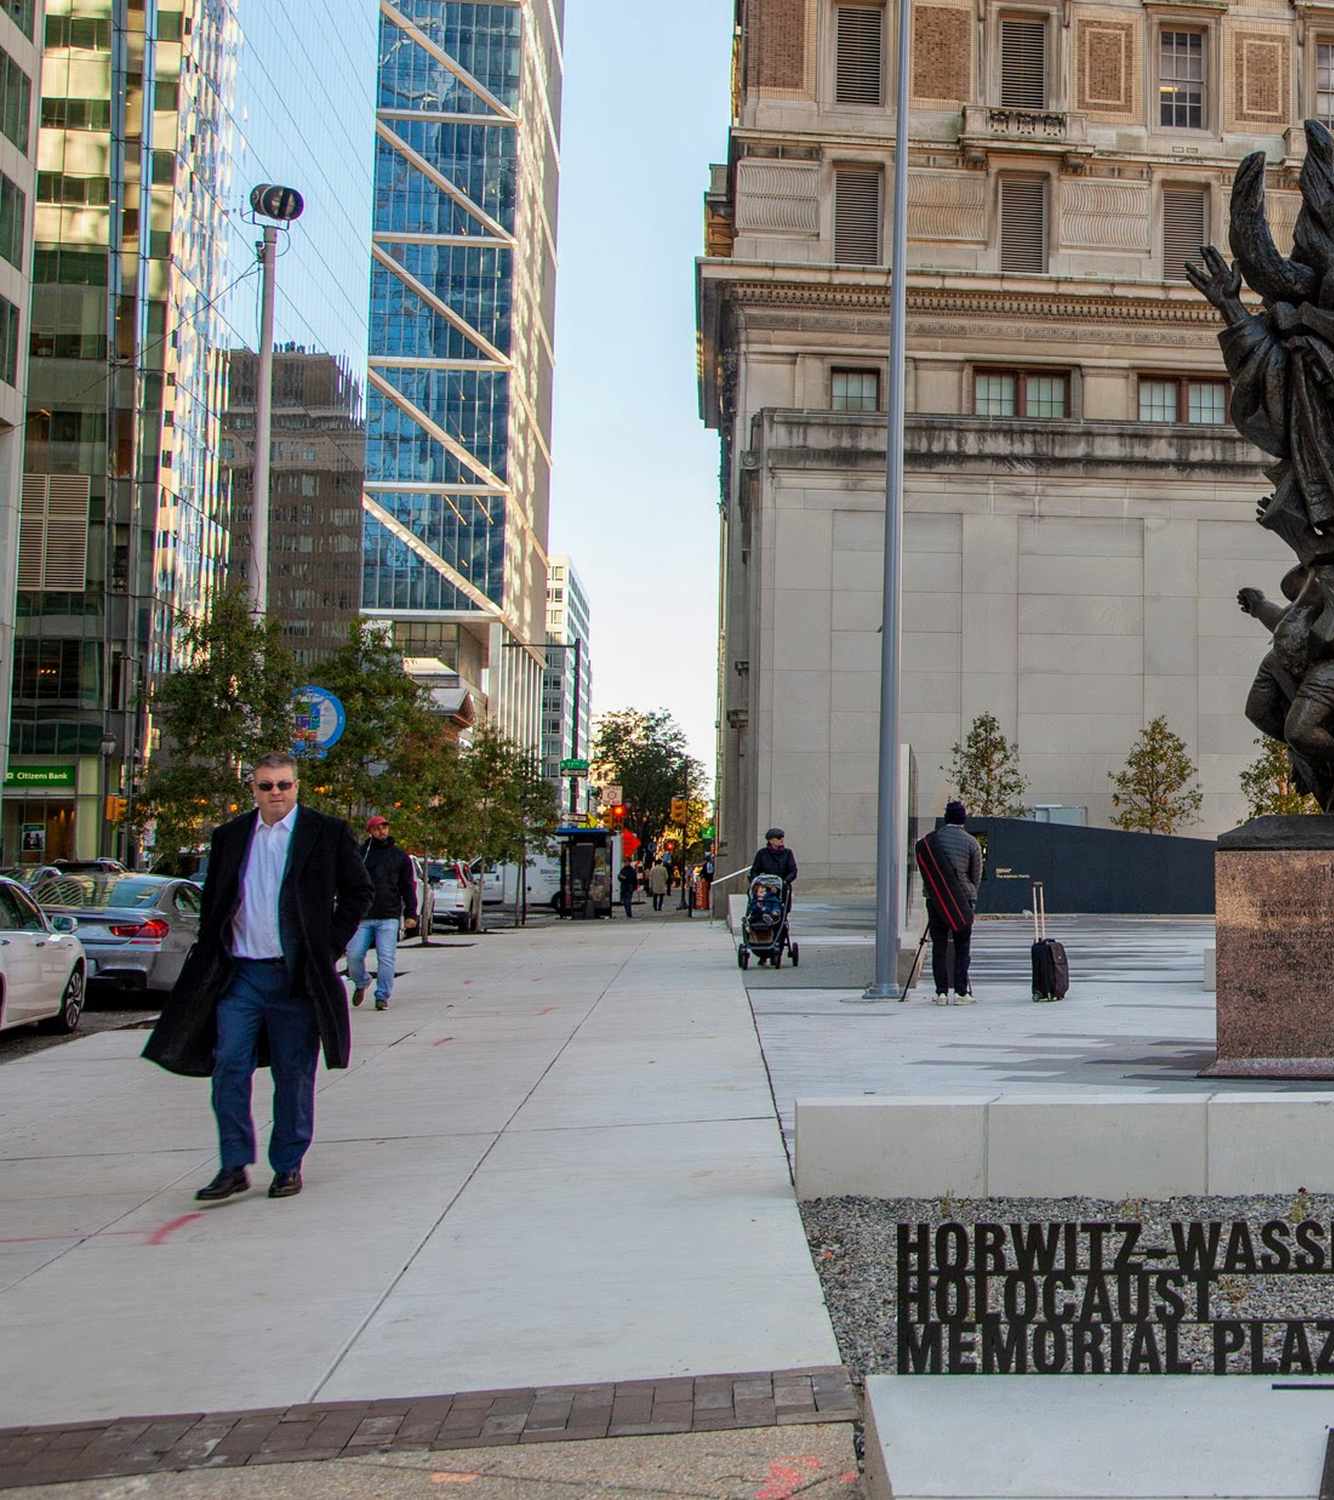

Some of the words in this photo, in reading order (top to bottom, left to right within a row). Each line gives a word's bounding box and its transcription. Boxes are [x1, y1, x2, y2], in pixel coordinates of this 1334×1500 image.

[16, 771, 48, 780] Citizens
[48, 771, 68, 780] Bank
[897, 1272, 1220, 1323] HOLOCAUST
[897, 1322, 1192, 1374] MEMORIAL
